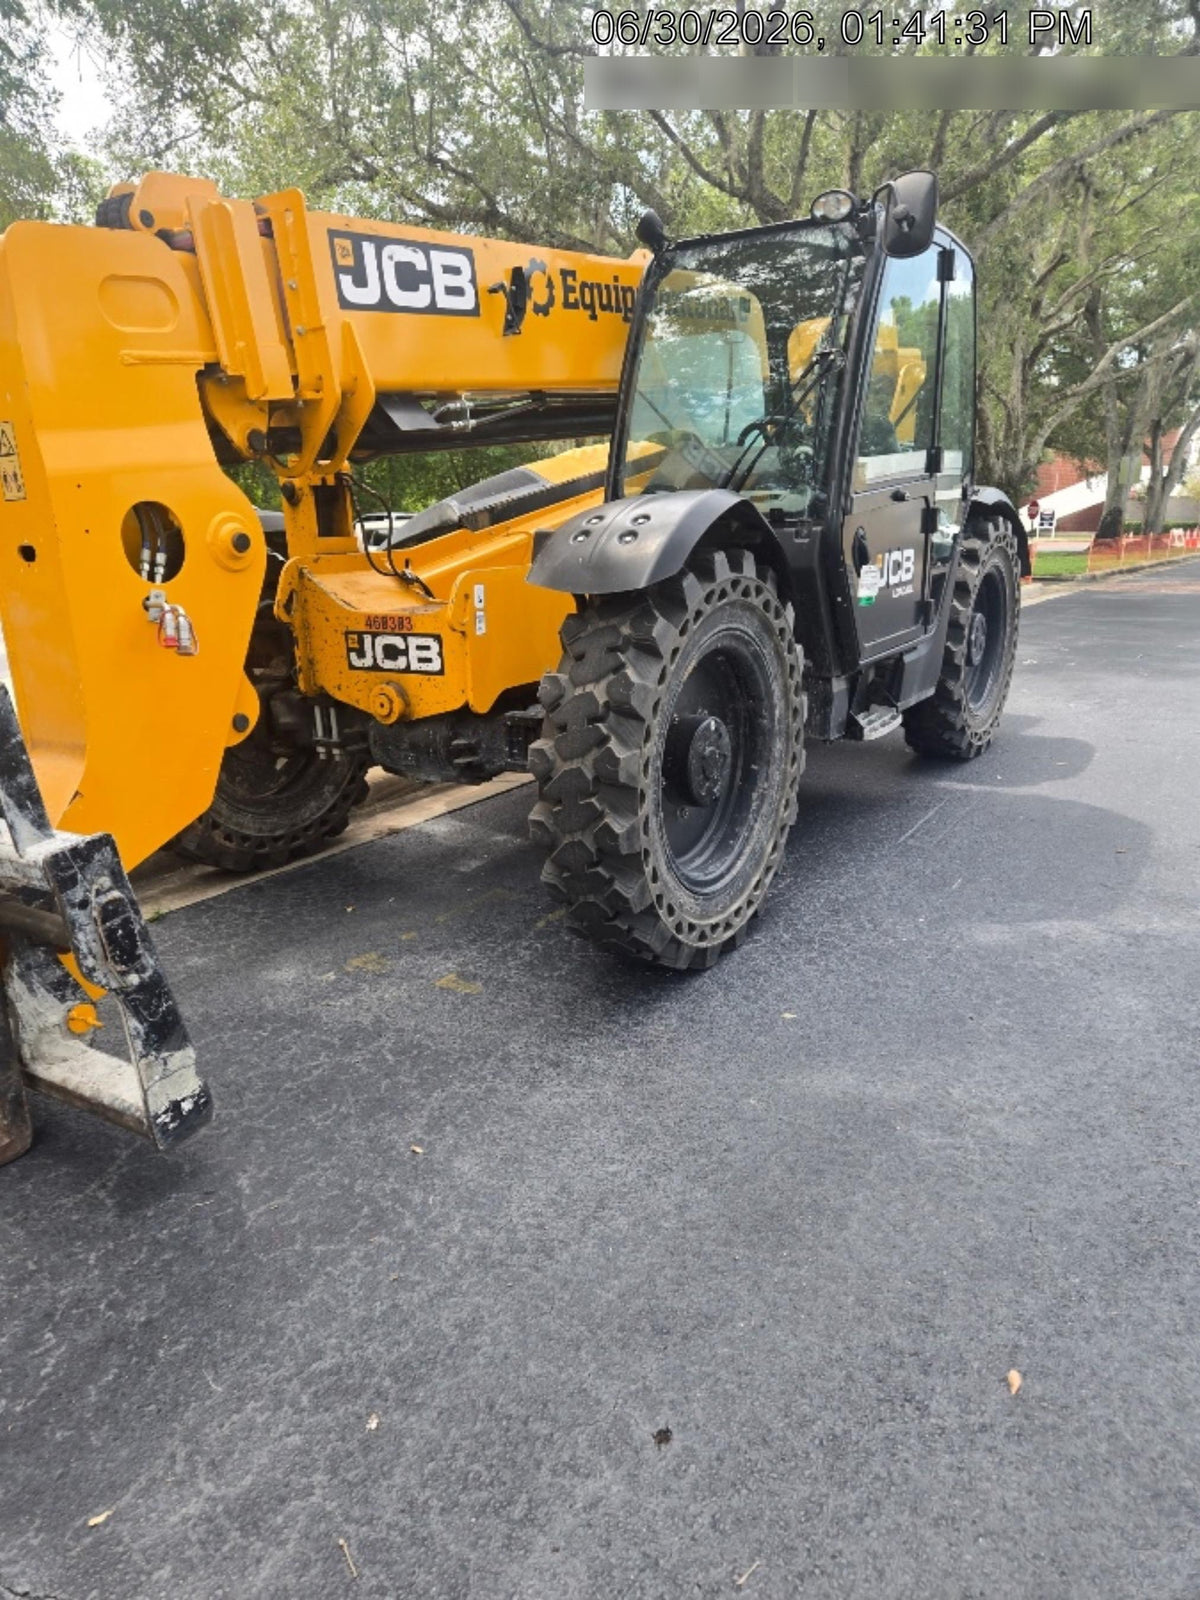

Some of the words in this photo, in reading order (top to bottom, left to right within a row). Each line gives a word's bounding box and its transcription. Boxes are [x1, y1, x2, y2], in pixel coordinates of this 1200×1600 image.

[339, 241, 476, 310] JCB
[560, 267, 638, 323] Equip
[877, 548, 915, 588] JCB
[349, 634, 442, 672] JCB
